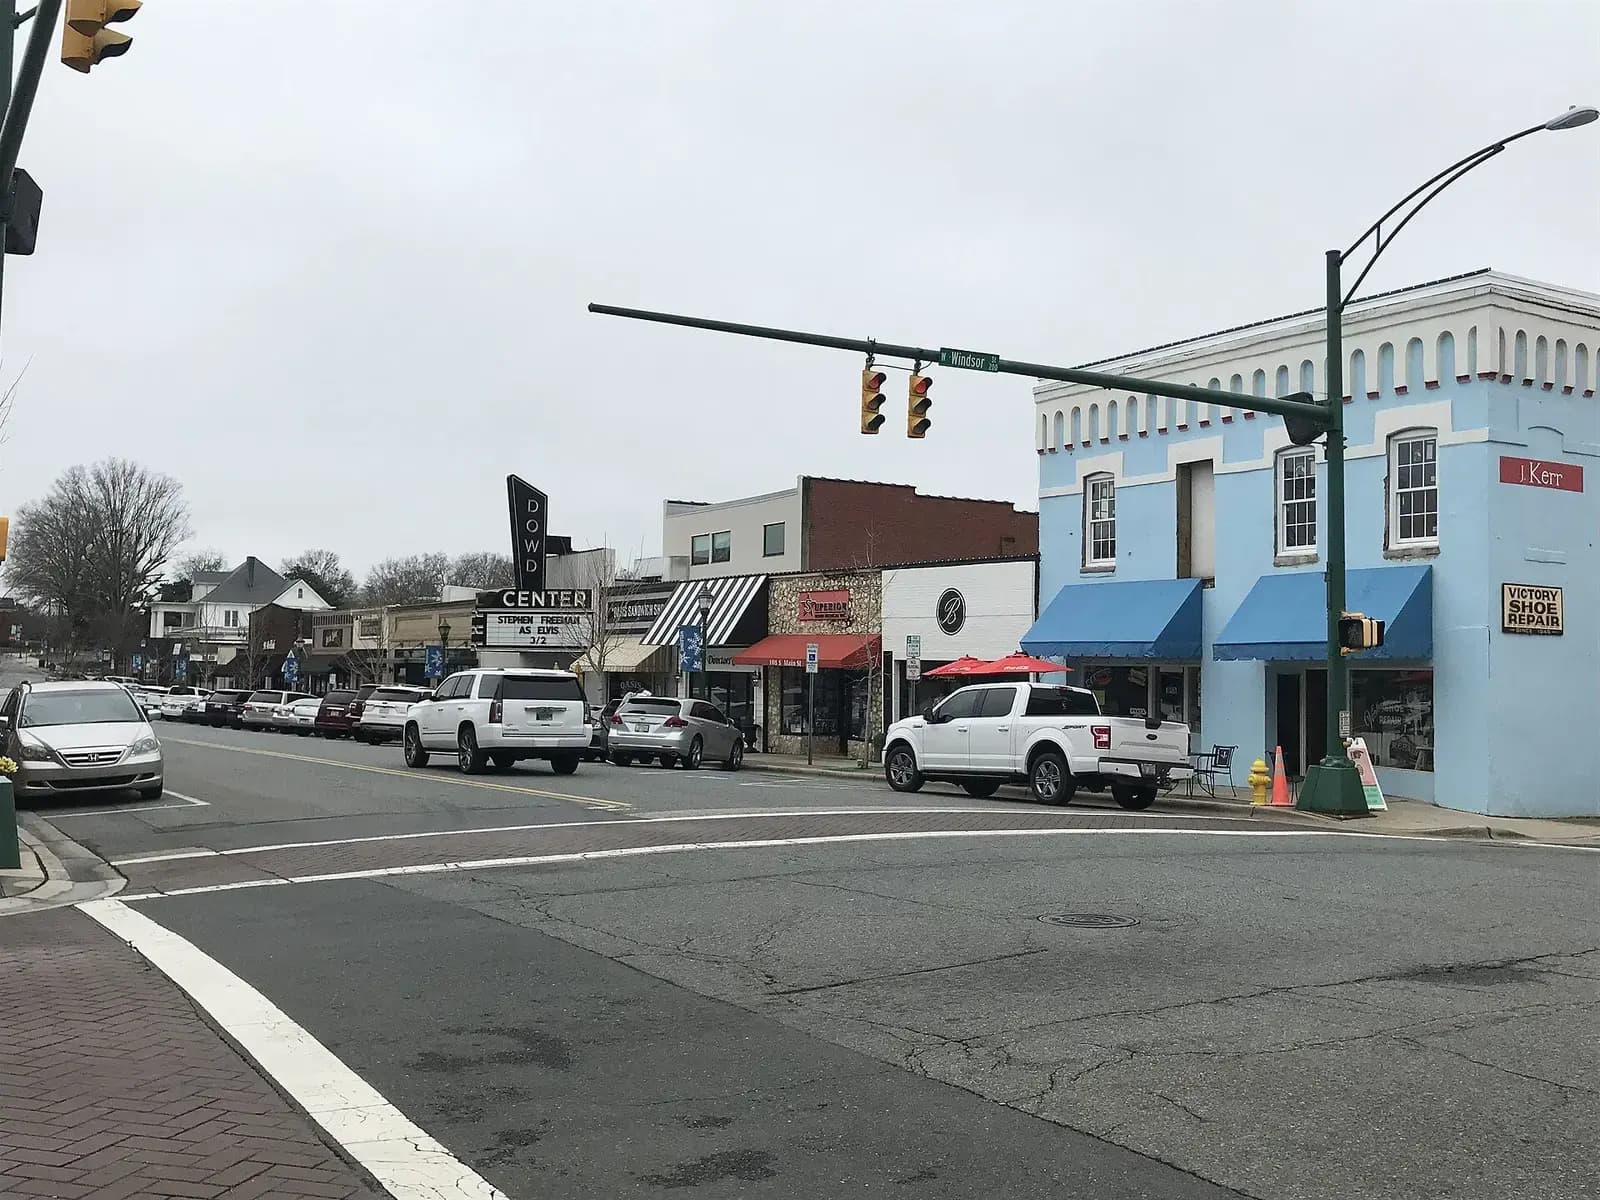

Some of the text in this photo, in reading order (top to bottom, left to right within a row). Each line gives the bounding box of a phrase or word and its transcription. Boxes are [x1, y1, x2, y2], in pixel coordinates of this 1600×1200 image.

[951, 351, 985, 369] Windsor
[1529, 461, 1564, 487] Kerr
[524, 499, 540, 573] DOWD
[502, 590, 586, 607] CENTER
[1508, 587, 1559, 602] VICTORY
[628, 604, 653, 617] SANDWICH
[804, 600, 848, 612] SUPERIOR
[1509, 600, 1557, 615] SHOE
[498, 615, 580, 625] STEPHEN FREEMAN
[1508, 613, 1560, 627] REPAIR
[519, 626, 560, 635] AS ELVIS
[530, 636, 547, 645] 3/2
[783, 659, 796, 667] Main
